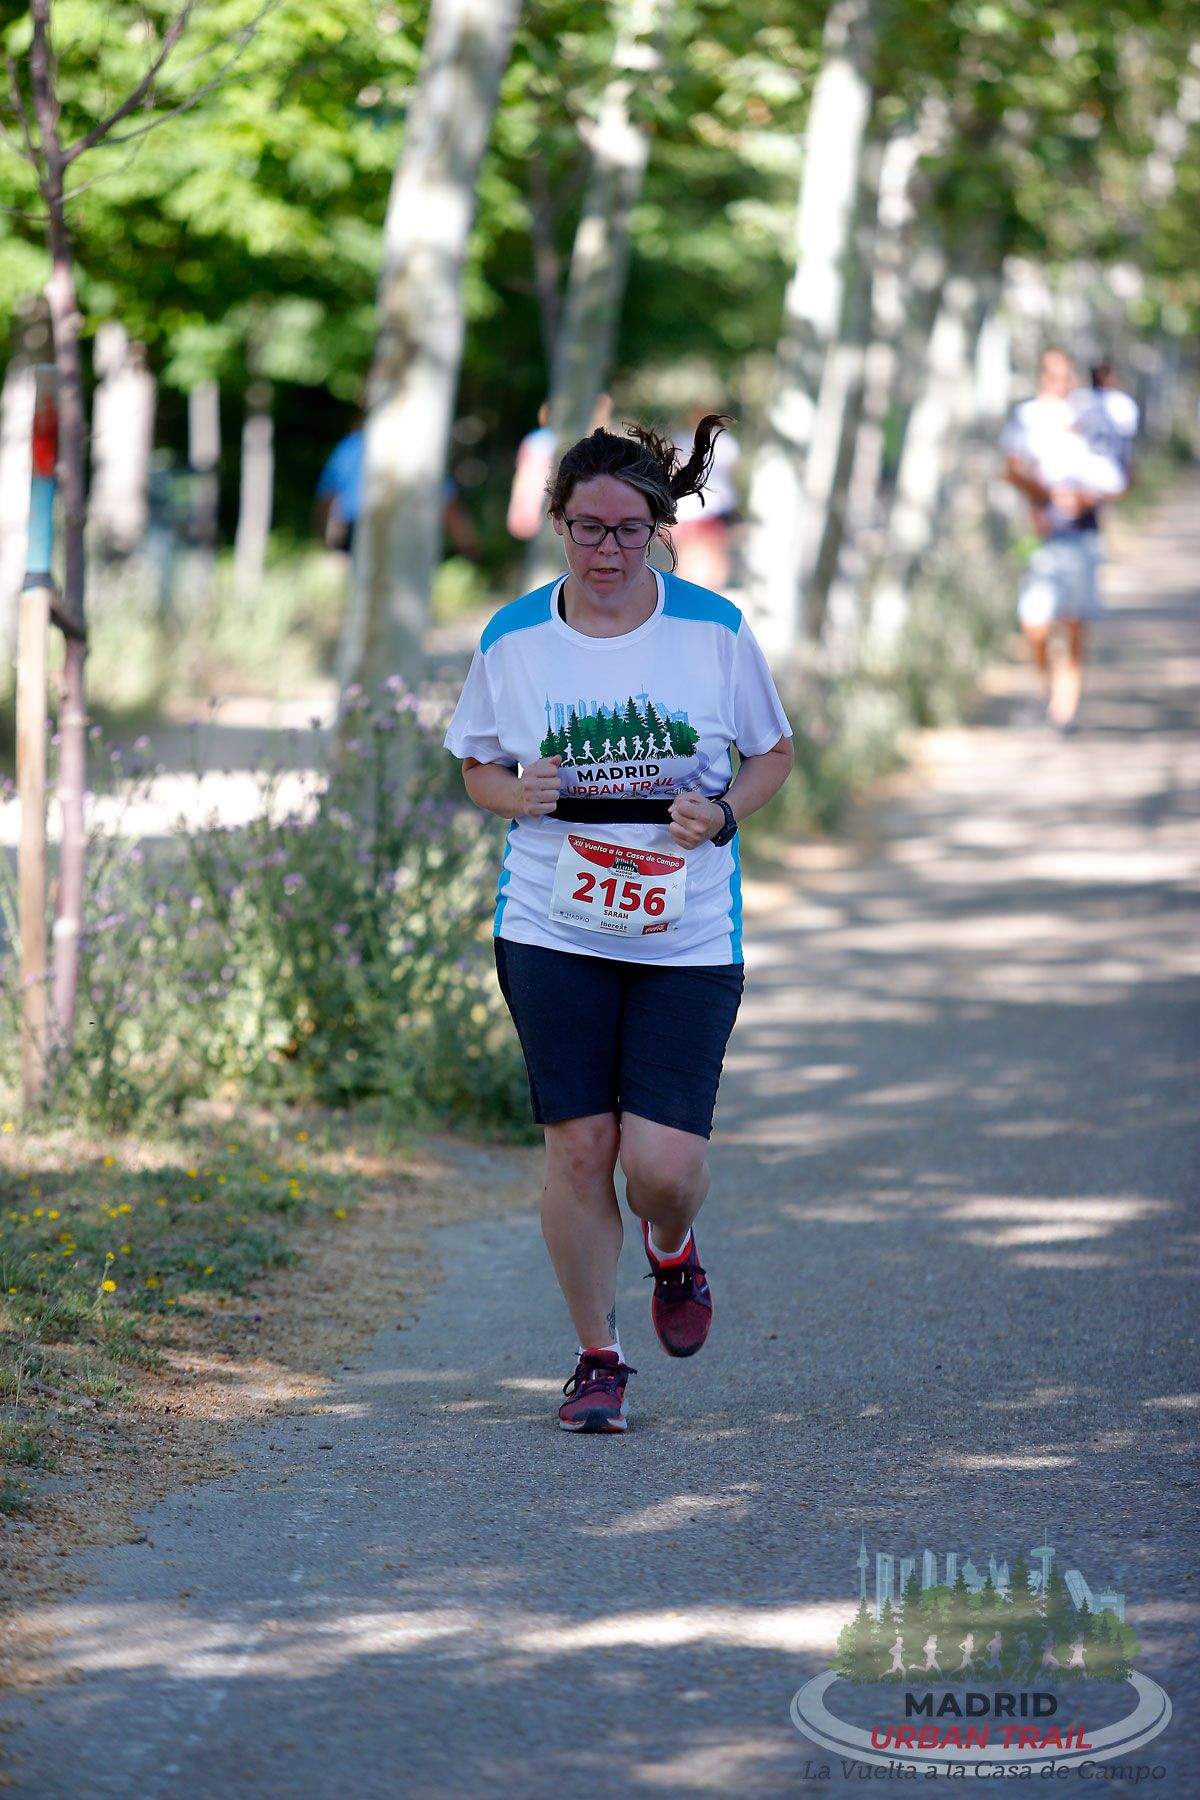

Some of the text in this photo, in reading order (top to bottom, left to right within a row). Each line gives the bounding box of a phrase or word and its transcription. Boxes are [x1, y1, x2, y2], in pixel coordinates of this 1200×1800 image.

[576, 764, 660, 782] MADRID
[566, 782, 625, 797] URBAN
[584, 841, 608, 853] Vuelta
[615, 848, 624, 856] la
[625, 851, 645, 861] Casa
[645, 855, 656, 863] de
[656, 857, 680, 868] Campo
[572, 872, 666, 917] 2156
[603, 910, 629, 920] SARAH
